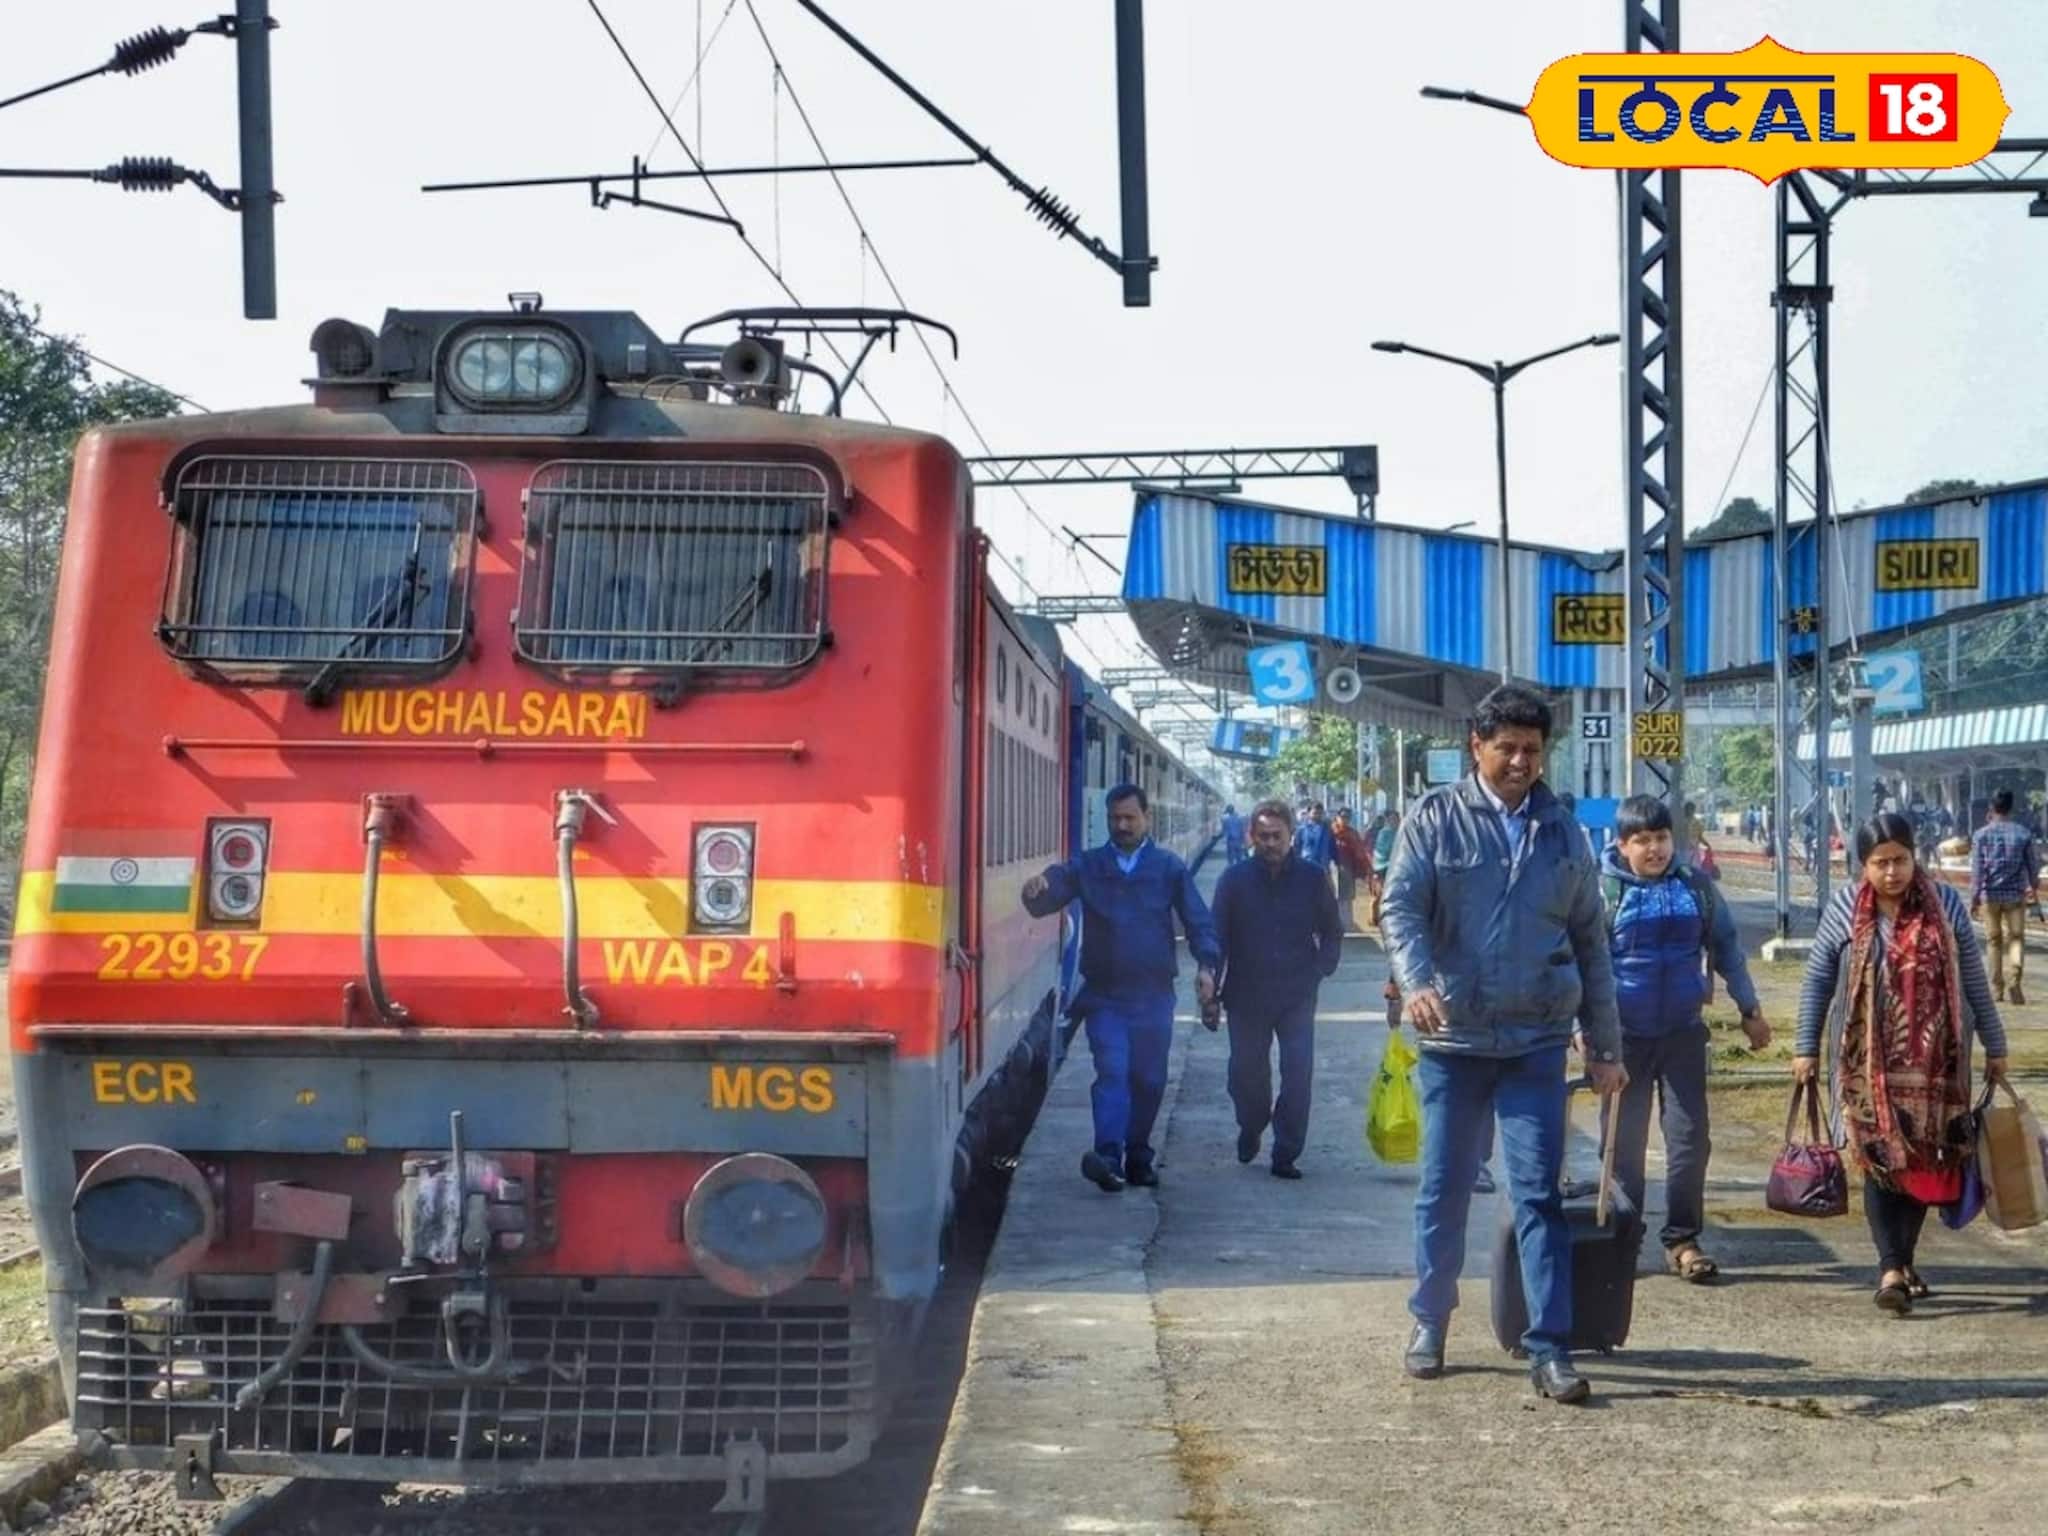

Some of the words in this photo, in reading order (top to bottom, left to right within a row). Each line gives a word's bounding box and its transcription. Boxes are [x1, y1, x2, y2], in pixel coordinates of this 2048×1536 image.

[1884, 547, 1971, 583] SIURI
[1557, 599, 1625, 637] सिउ
[1257, 646, 1307, 699] 3
[1866, 656, 1918, 709] 2
[341, 689, 647, 738] MUGHALSARAI
[1584, 719, 1609, 736] 31
[1634, 713, 1680, 734] SURI
[1634, 738, 1680, 756] 1022
[98, 933, 270, 981] 22937
[602, 939, 733, 986] WAP
[741, 944, 770, 990] 4
[93, 1061, 197, 1104] ECR
[710, 1065, 834, 1113] MGS
